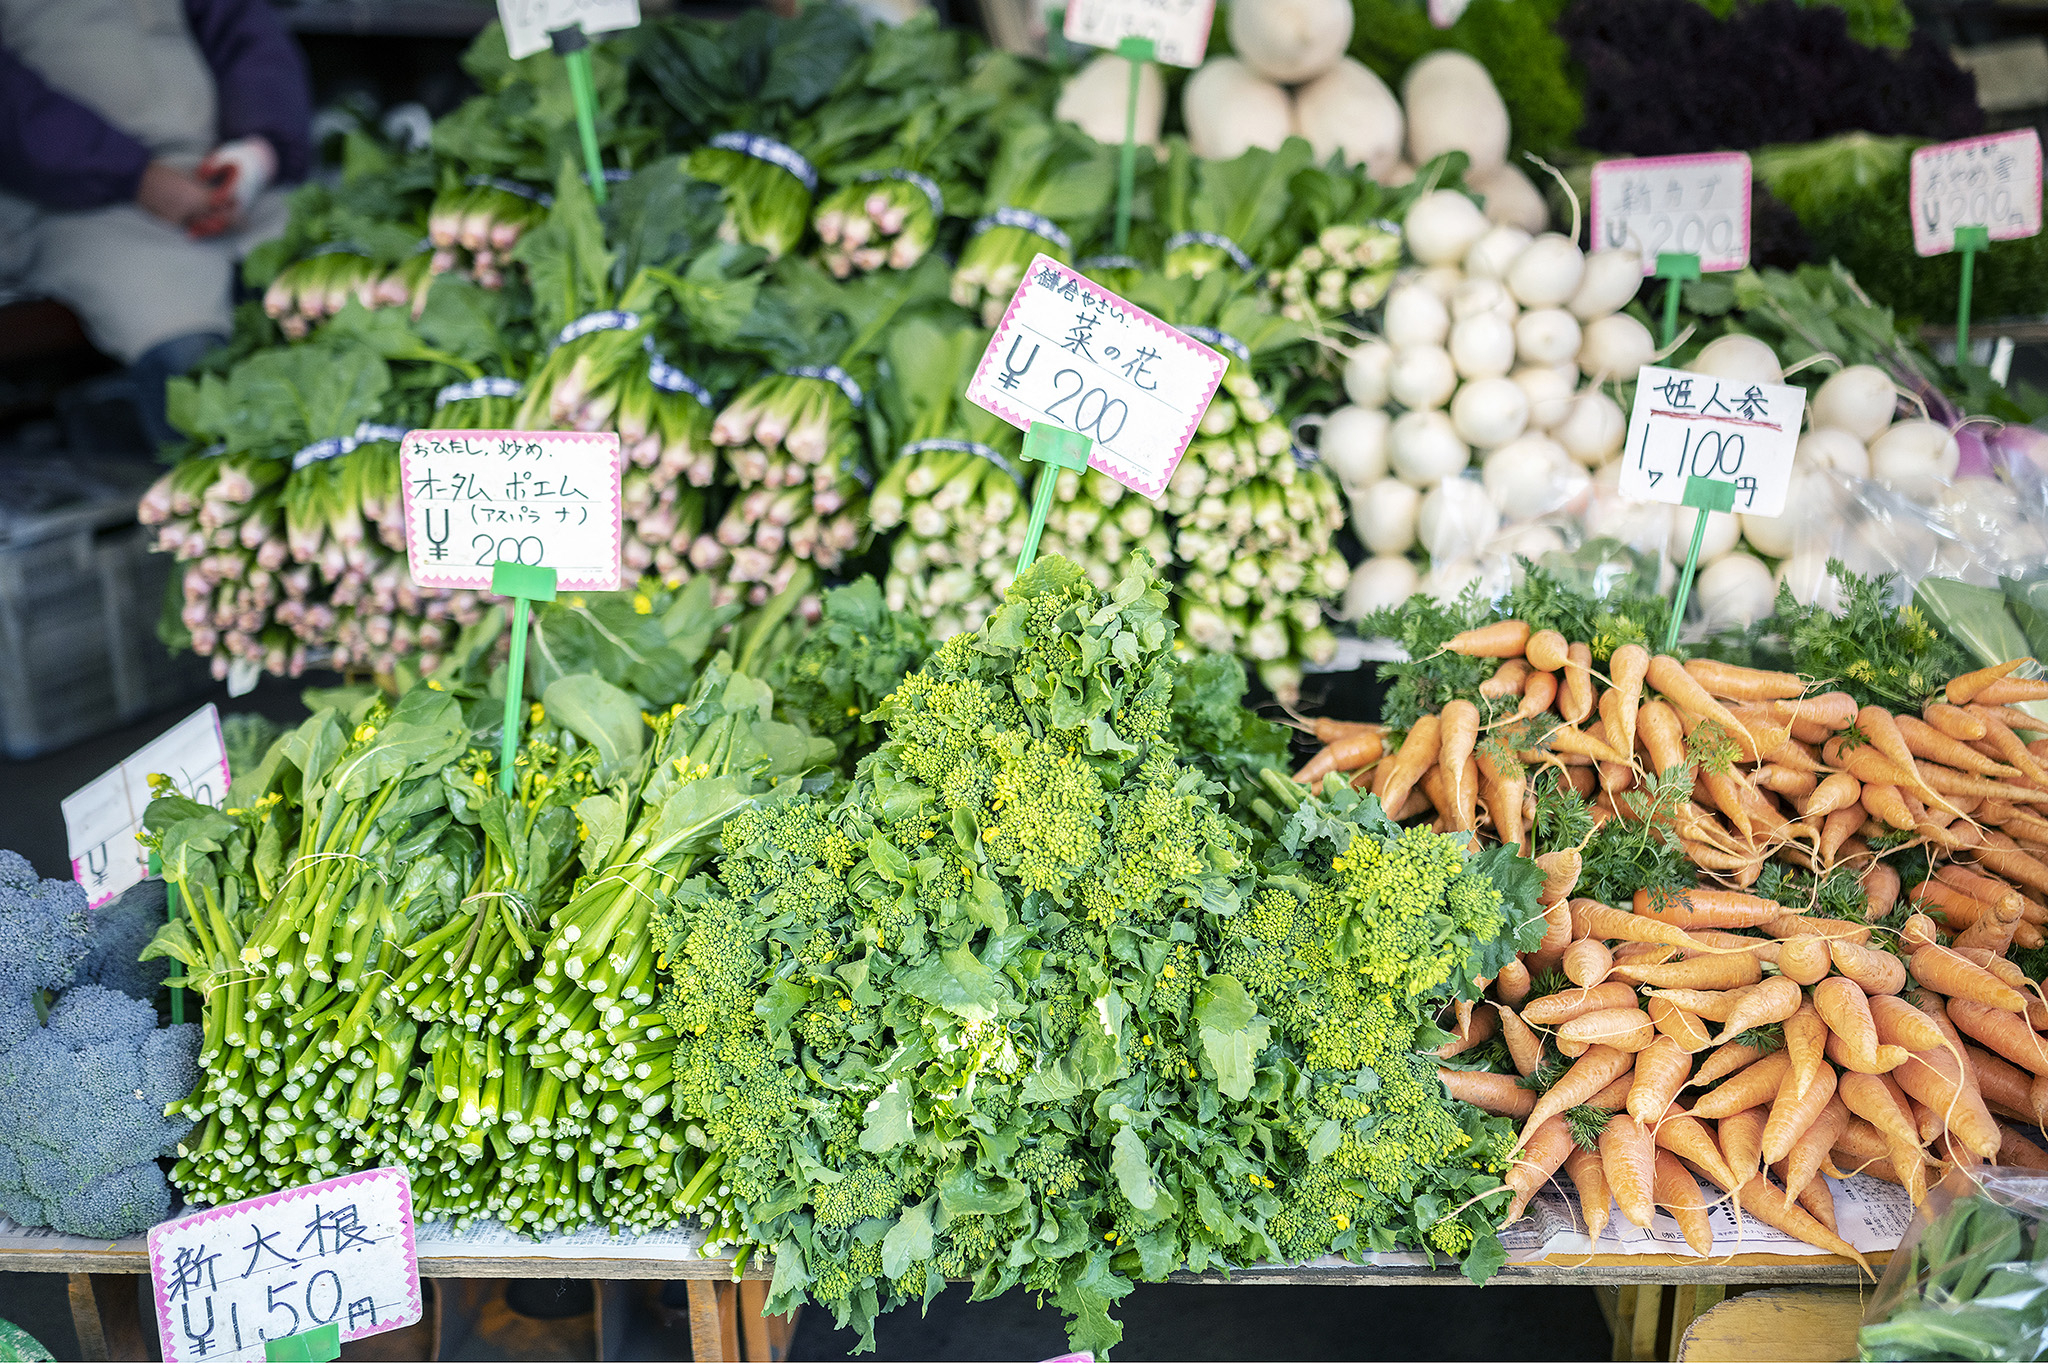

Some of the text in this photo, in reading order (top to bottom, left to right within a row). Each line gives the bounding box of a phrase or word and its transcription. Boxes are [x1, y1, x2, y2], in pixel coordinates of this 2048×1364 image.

[1061, 312, 1162, 390] 菜の花
[1653, 376, 1768, 420] 姫人参
[167, 1204, 376, 1301] 新大根
